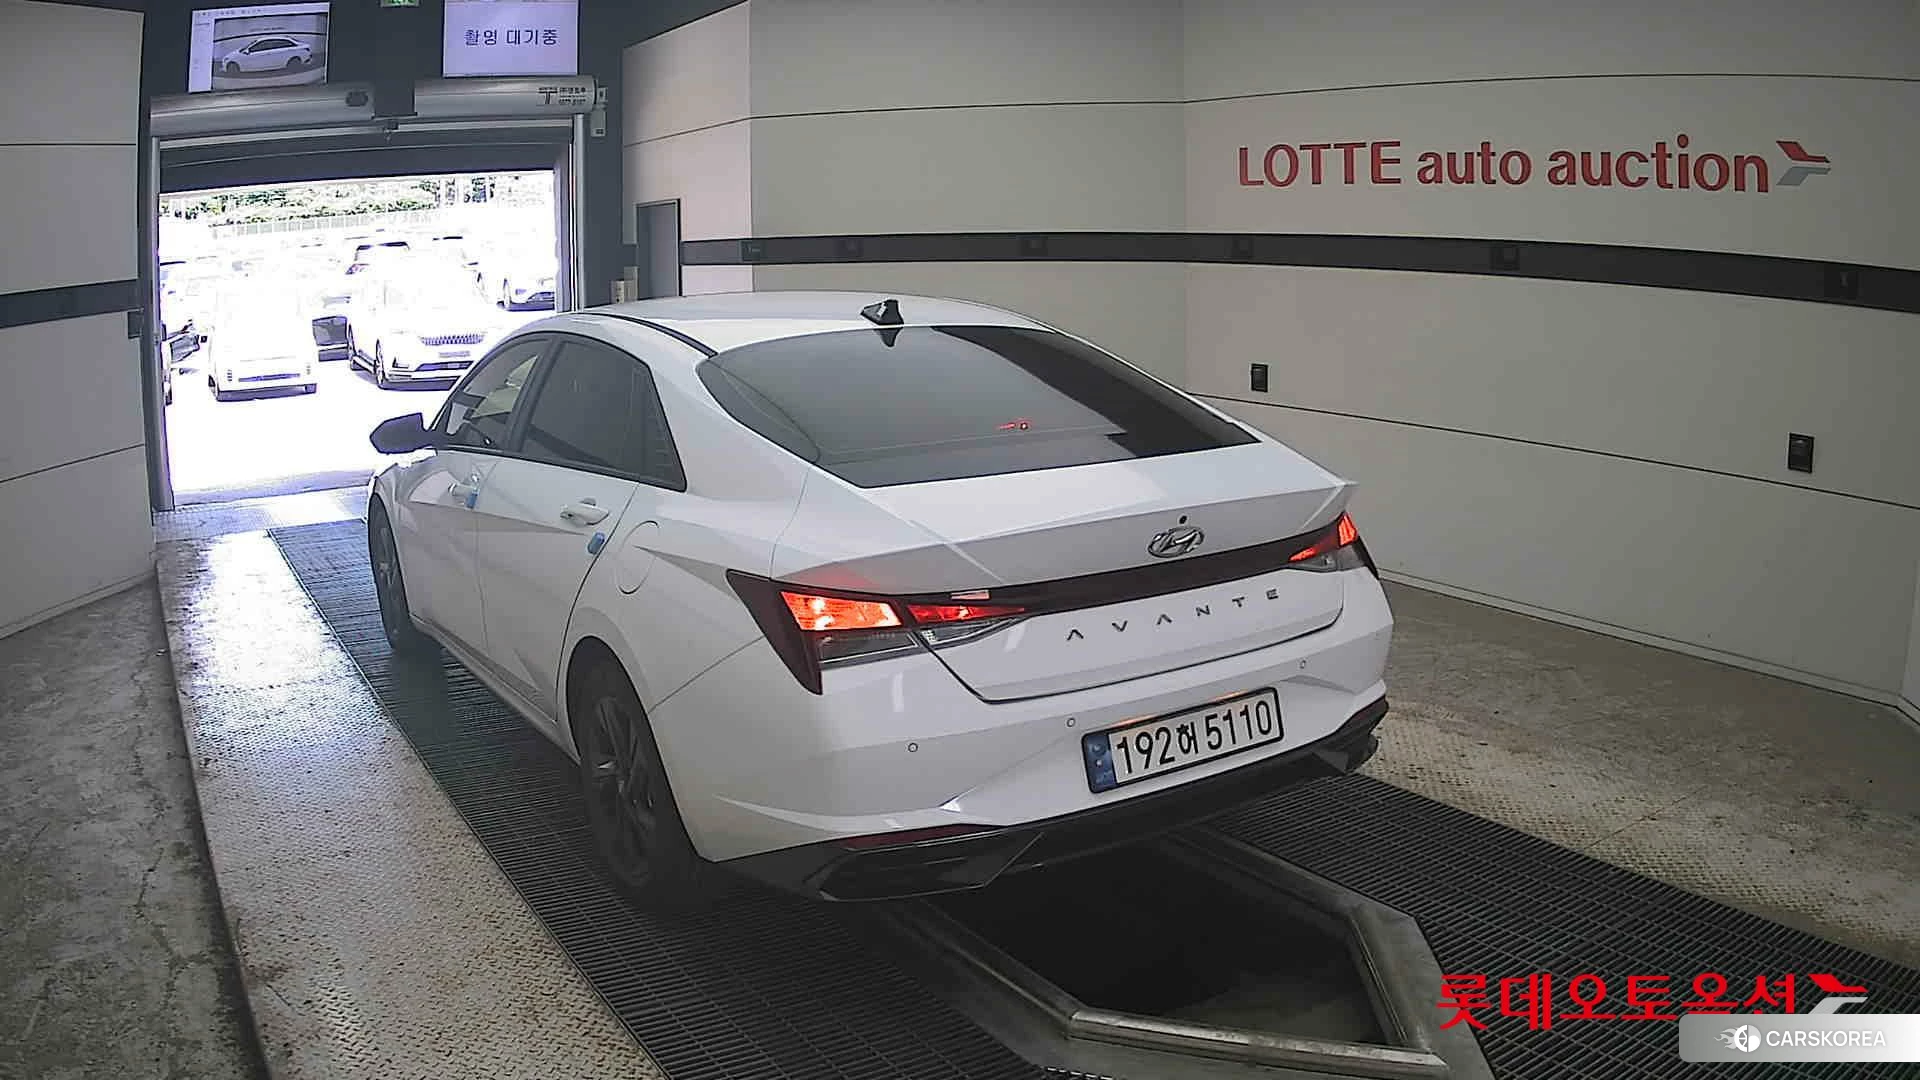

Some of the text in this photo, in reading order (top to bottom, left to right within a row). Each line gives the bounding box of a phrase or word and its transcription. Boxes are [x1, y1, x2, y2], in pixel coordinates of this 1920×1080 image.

[506, 29, 559, 46] 대기중
[1239, 134, 1769, 193] LOTTE auto auction
[1066, 588, 1279, 641] AVANTE
